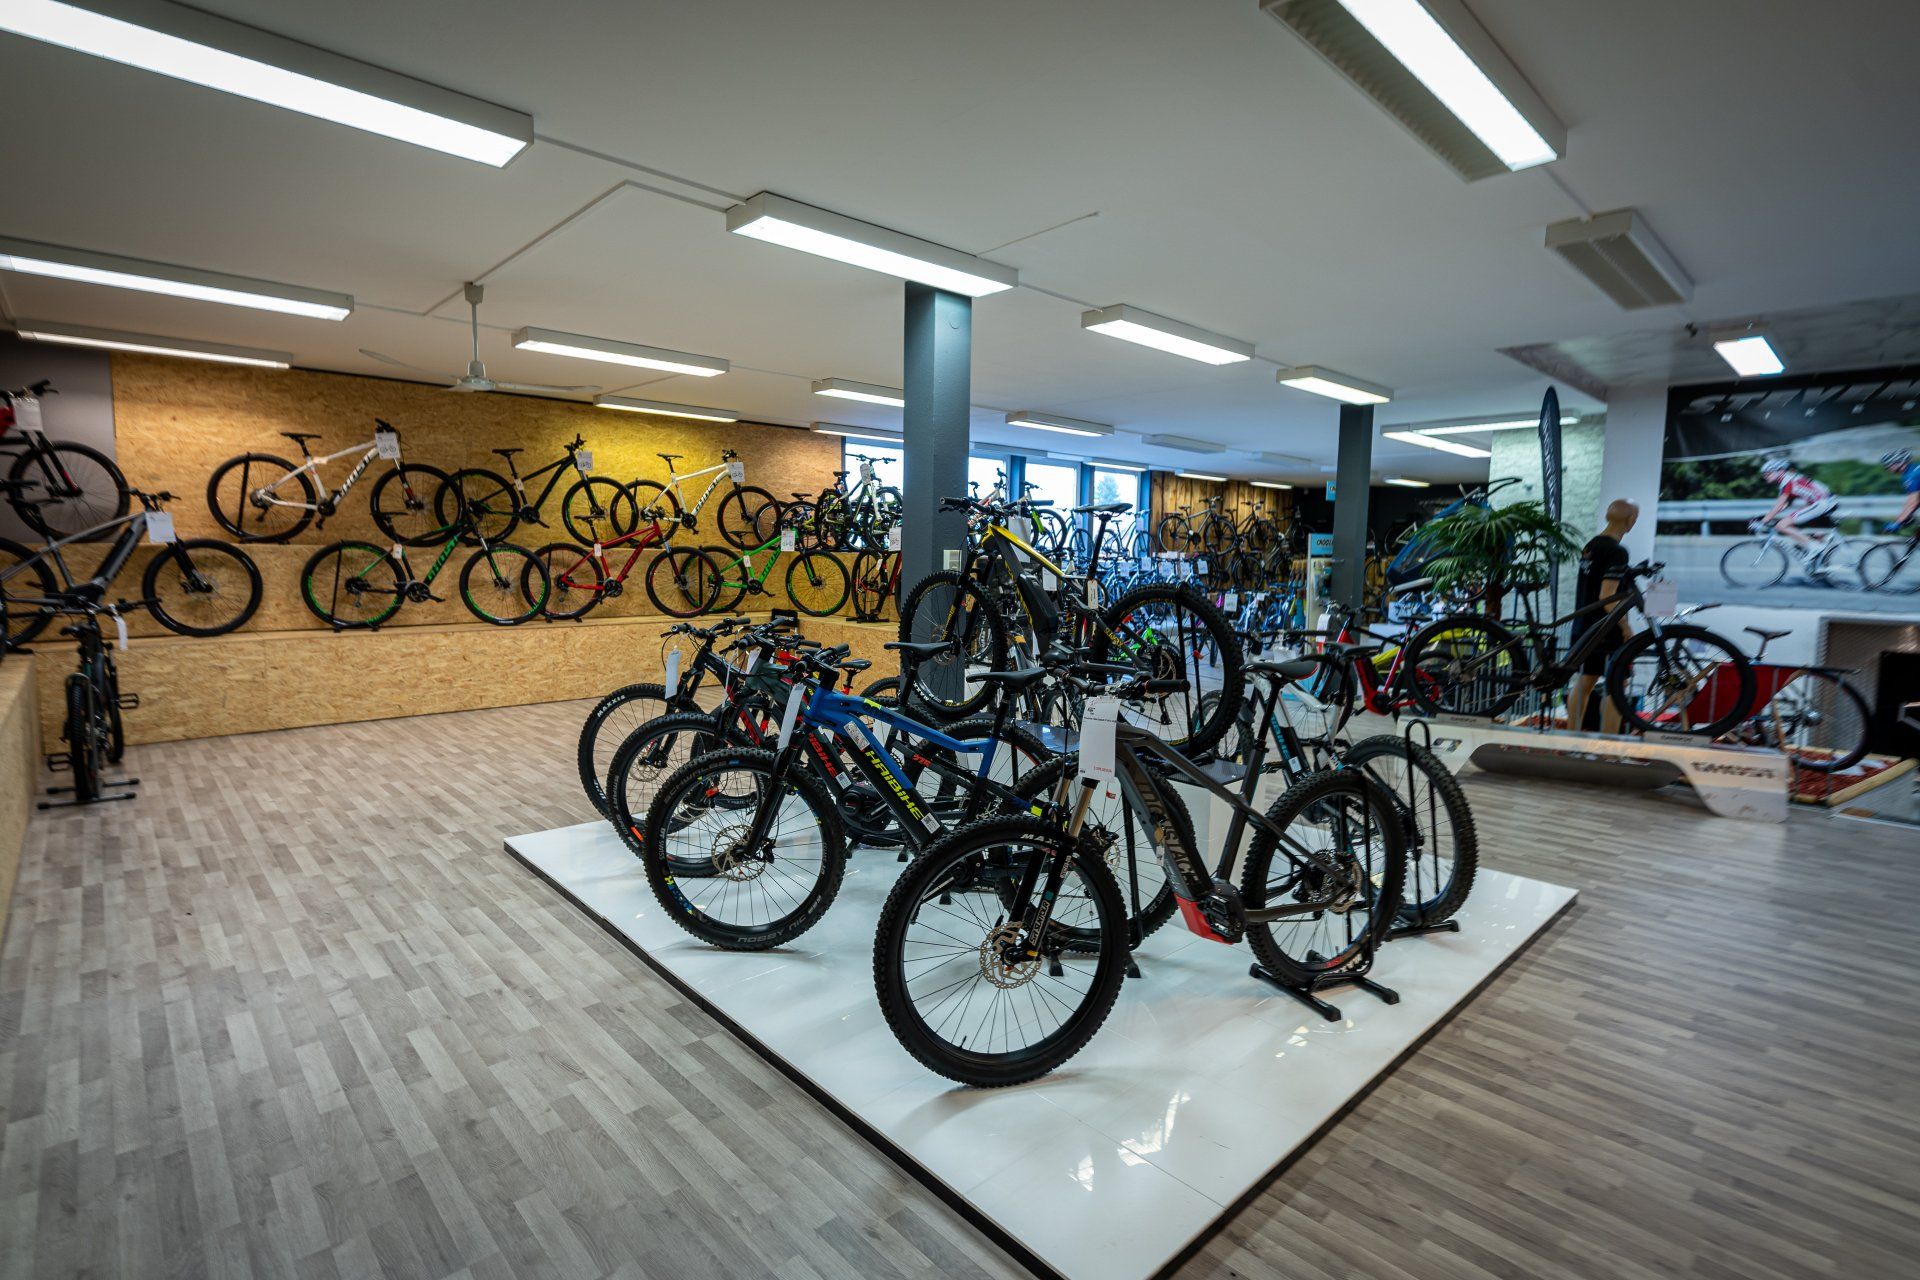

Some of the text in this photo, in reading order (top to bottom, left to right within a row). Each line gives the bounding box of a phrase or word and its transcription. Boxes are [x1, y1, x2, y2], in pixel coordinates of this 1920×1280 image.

[696, 479, 718, 511] GHOST
[428, 536, 457, 580] GHOST
[597, 694, 626, 718] MAXXIS
[865, 750, 925, 820] HAIBIKE
